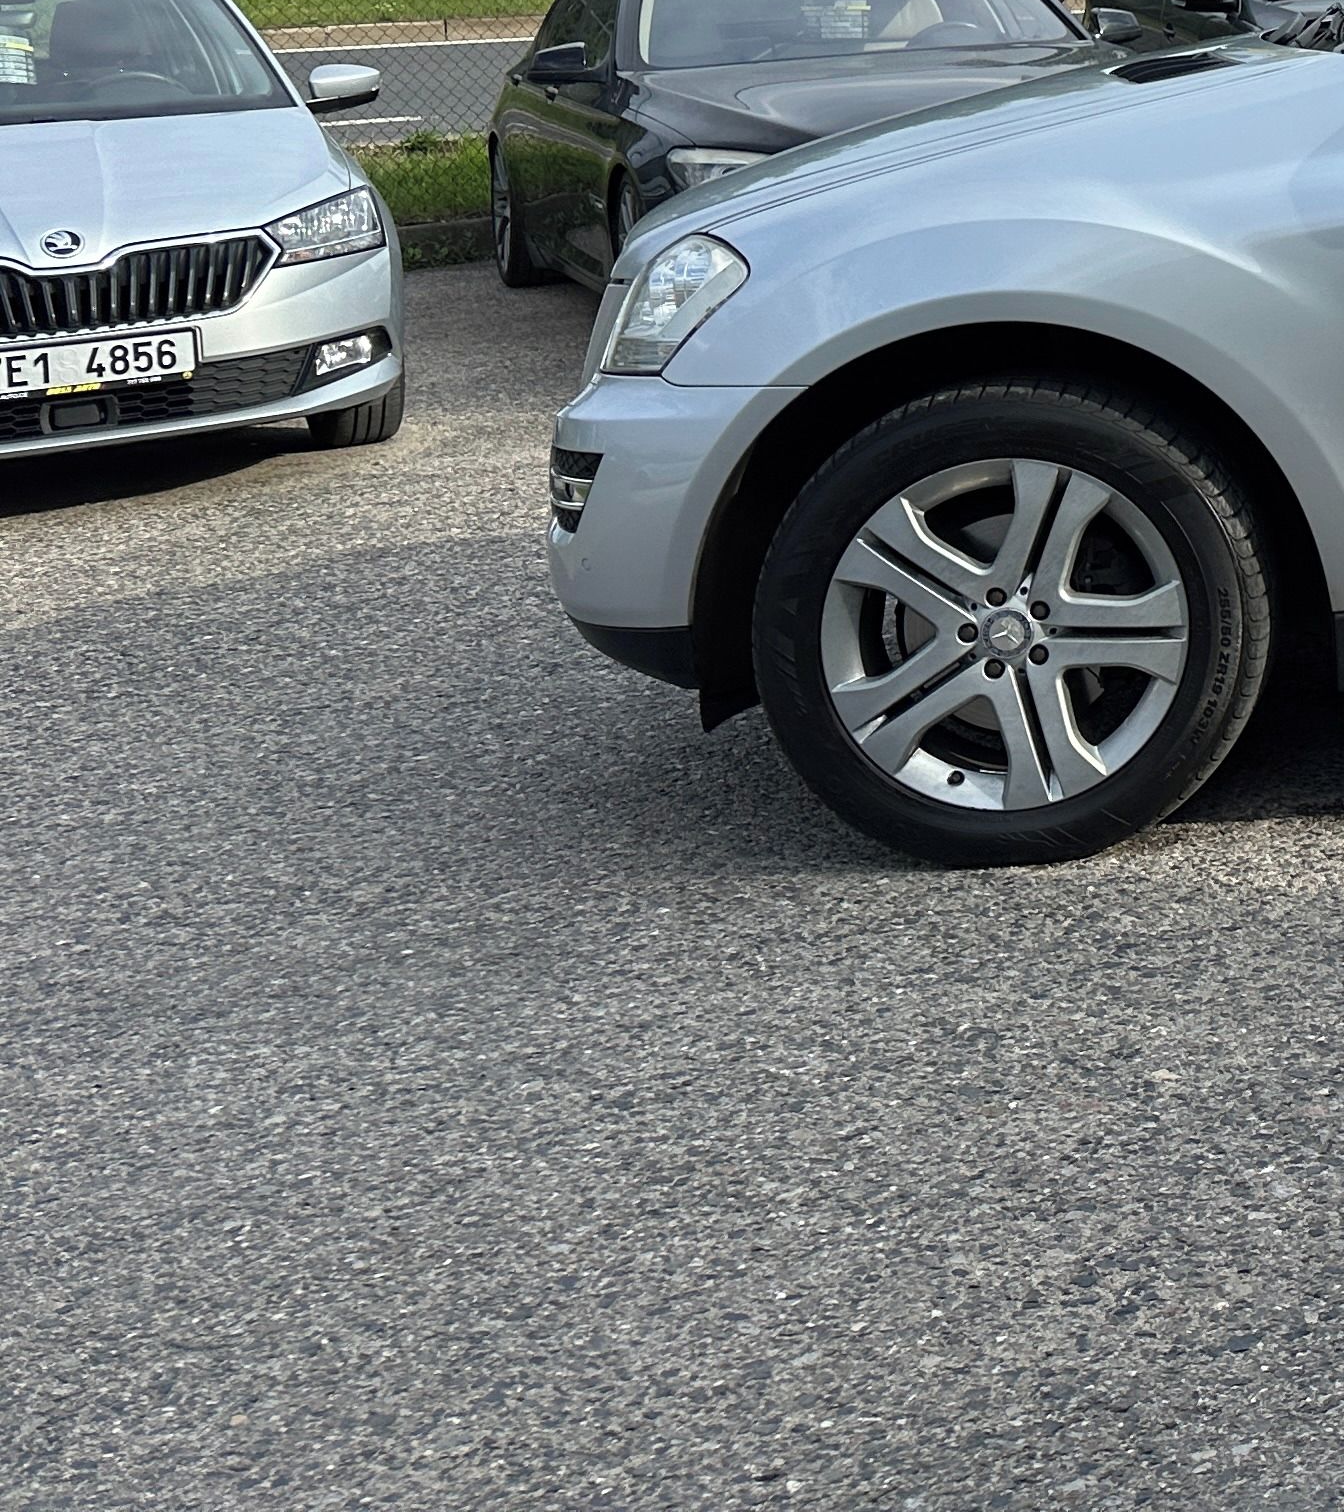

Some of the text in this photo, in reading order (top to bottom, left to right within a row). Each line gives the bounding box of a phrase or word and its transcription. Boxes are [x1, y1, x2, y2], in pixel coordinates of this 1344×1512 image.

[0, 339, 178, 388] E1 4856
[1217, 588, 1232, 647] 255/50
[1213, 653, 1230, 695] ZR19
